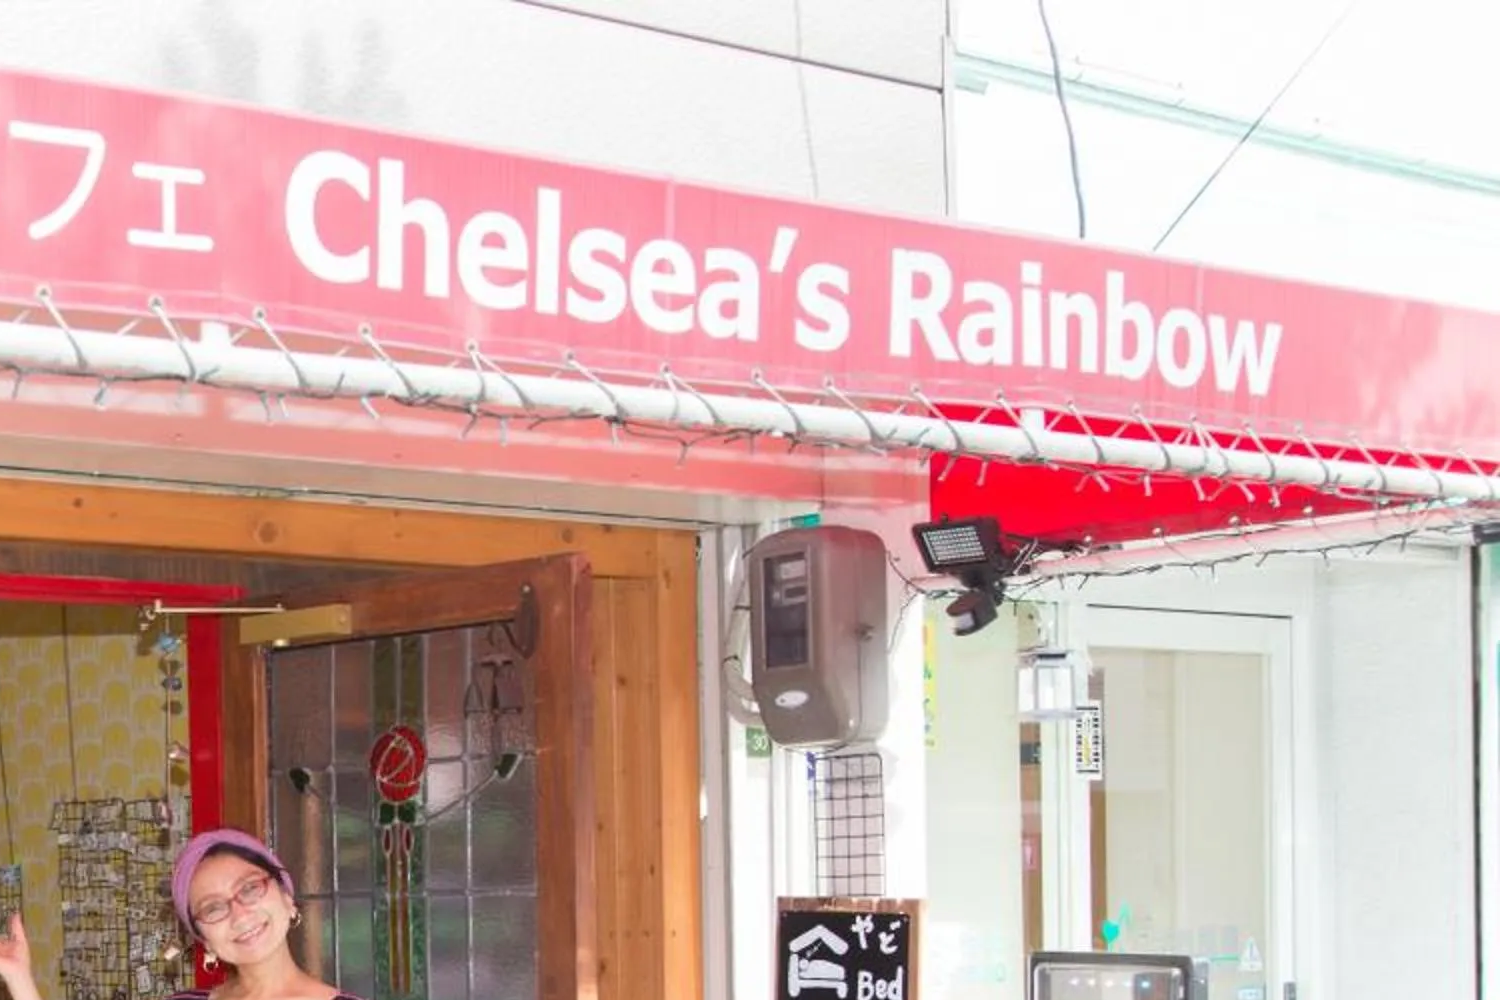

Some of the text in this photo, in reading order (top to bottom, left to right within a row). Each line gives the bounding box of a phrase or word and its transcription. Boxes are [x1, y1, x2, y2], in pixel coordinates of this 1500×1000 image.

[284, 150, 851, 353] Chelsea's
[888, 247, 1283, 397] Rainbow
[851, 914, 901, 954] やど
